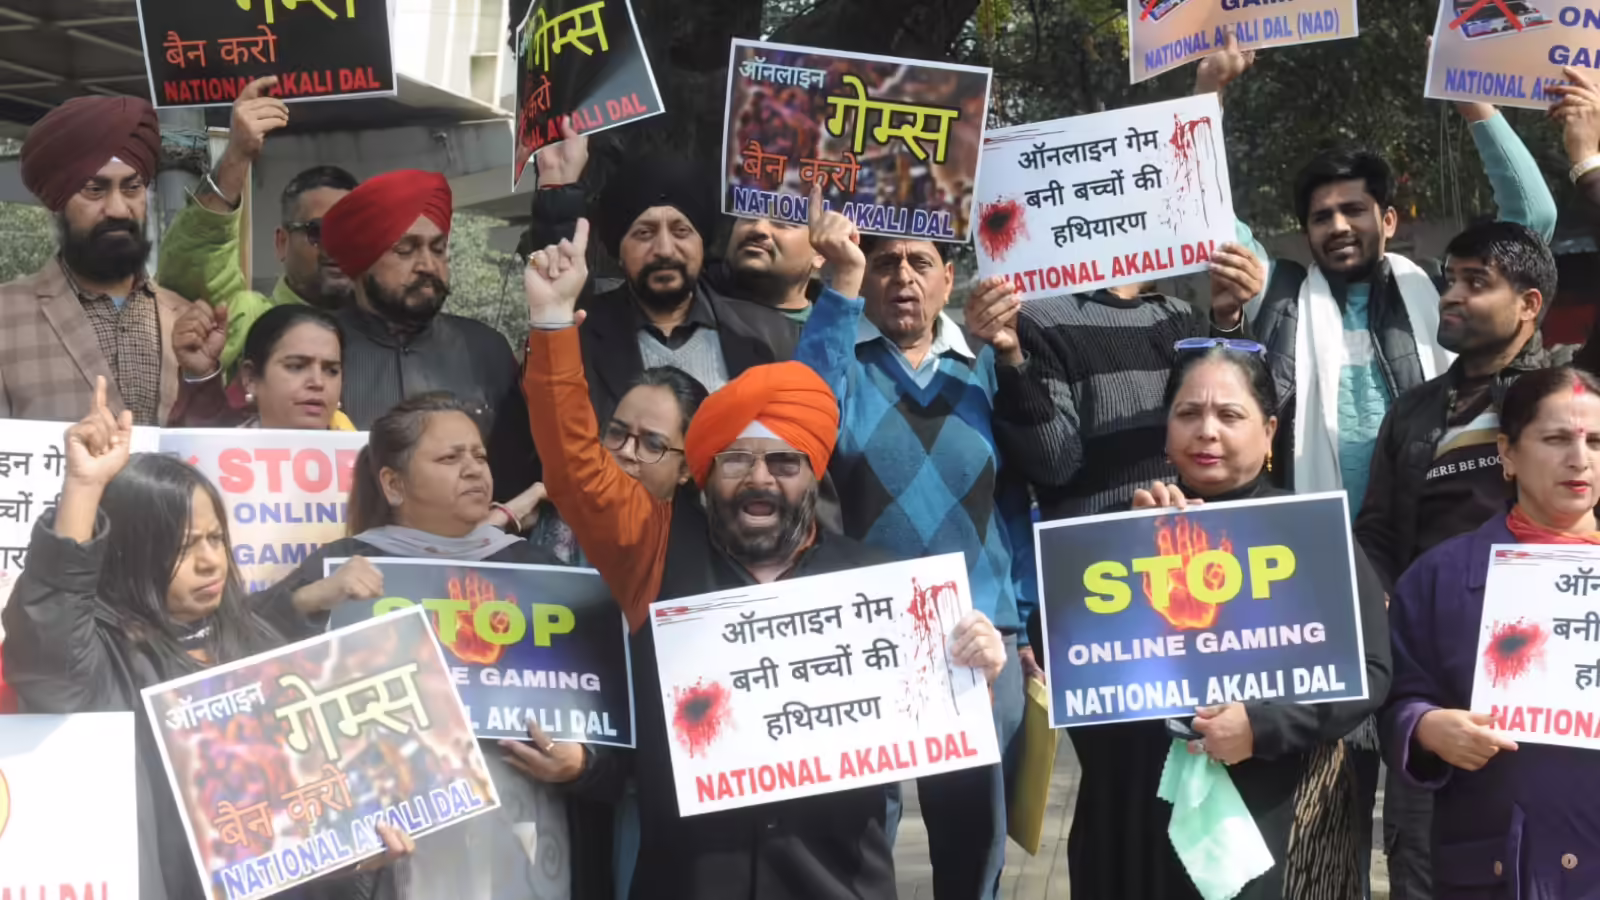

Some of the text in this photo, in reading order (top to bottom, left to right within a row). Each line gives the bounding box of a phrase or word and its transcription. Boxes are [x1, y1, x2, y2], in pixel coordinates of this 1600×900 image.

[163, 25, 277, 68] बैन करो
[1144, 30, 1210, 71] NATIONAL
[1263, 16, 1292, 39] DAL
[1298, 7, 1339, 40] (NAD)
[164, 66, 380, 102] NATIONA AKALI DAL
[738, 56, 827, 89] ऑनलाइन
[1444, 67, 1526, 98] NATIONAL
[606, 93, 647, 121] DAL
[826, 75, 959, 162] गेम्स
[743, 140, 861, 192] बैन करो
[1018, 127, 1159, 170] ऑनलाइन गेम
[1025, 164, 1162, 209] बनी बच्चों की
[733, 187, 954, 236] NATION AKALI DAL
[1051, 211, 1147, 248] हथियारण
[1004, 260, 1104, 295] ATIONAL
[1112, 246, 1174, 278] AKALI
[43, 445, 67, 477] गे
[1459, 460, 1477, 472] BE
[1082, 544, 1296, 614] STOP
[722, 593, 894, 646] ऑनलाइन गेम
[730, 638, 899, 693] बनी बच्चों की
[1068, 622, 1326, 666] ONLINE GAMING
[480, 668, 600, 692] GAMING
[1065, 664, 1345, 717] NATIONAL AKALI DAL
[166, 681, 266, 731] ऑनलाइन
[275, 663, 430, 761] गेम्स
[487, 706, 562, 733] AKALI
[570, 709, 617, 737] DAL
[764, 696, 882, 740] हथियारण
[695, 730, 978, 803] NATIONAL AKALI DAL
[215, 764, 353, 847] बैन करो
[221, 779, 483, 900] NATIONAL AKALI DAL
